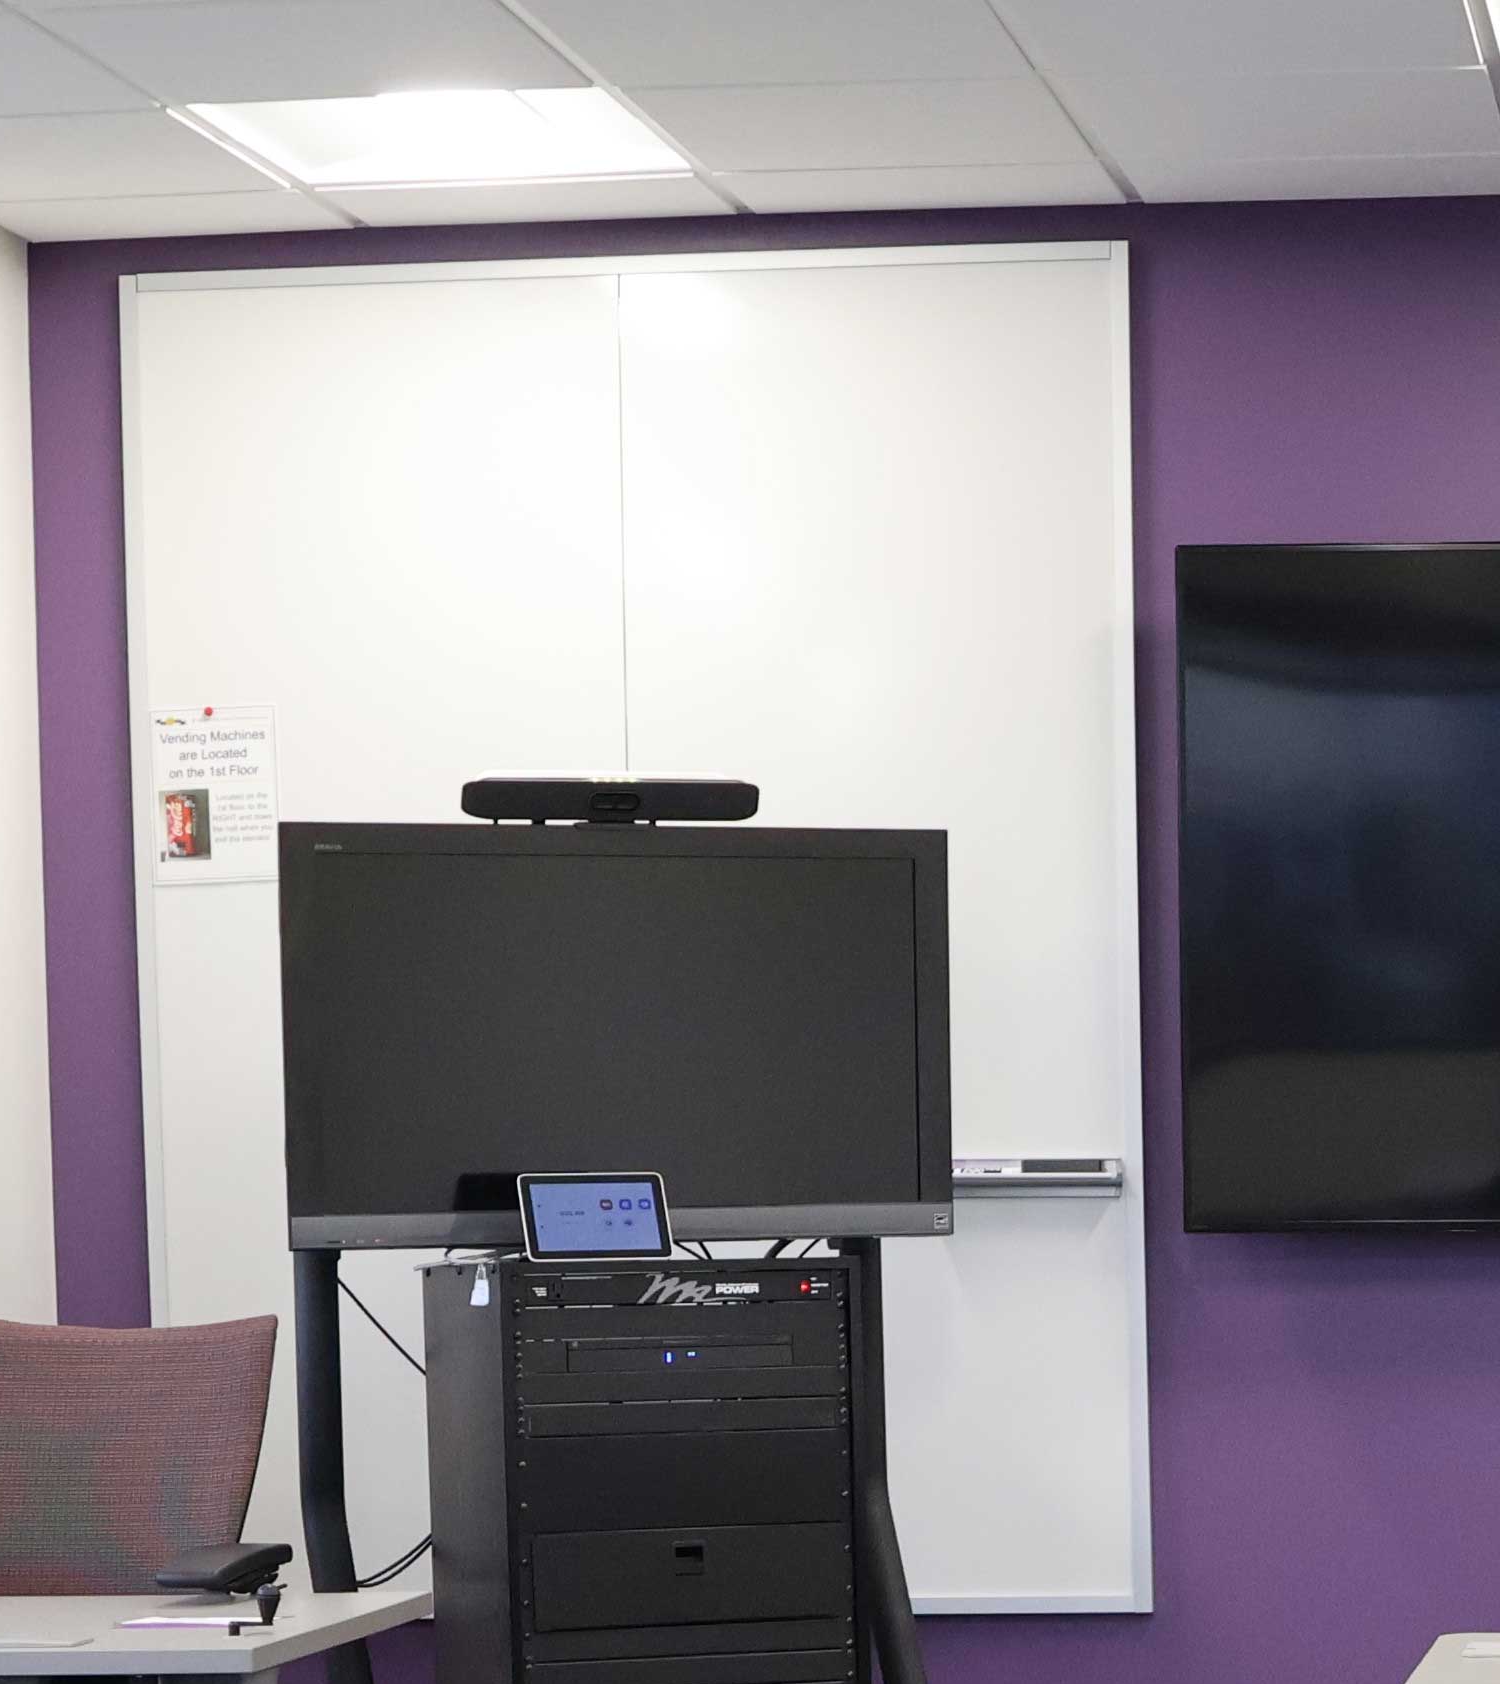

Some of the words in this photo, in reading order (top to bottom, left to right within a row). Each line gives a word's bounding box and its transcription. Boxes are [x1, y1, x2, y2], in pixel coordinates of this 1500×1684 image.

[160, 733, 206, 744] Vending
[210, 730, 265, 742] Machines
[179, 752, 198, 760] are
[202, 747, 247, 760] Located
[169, 770, 183, 778] on
[187, 768, 205, 777] the
[210, 767, 225, 776] 1st
[229, 765, 259, 776] Floor
[716, 1286, 759, 1294] POWER
